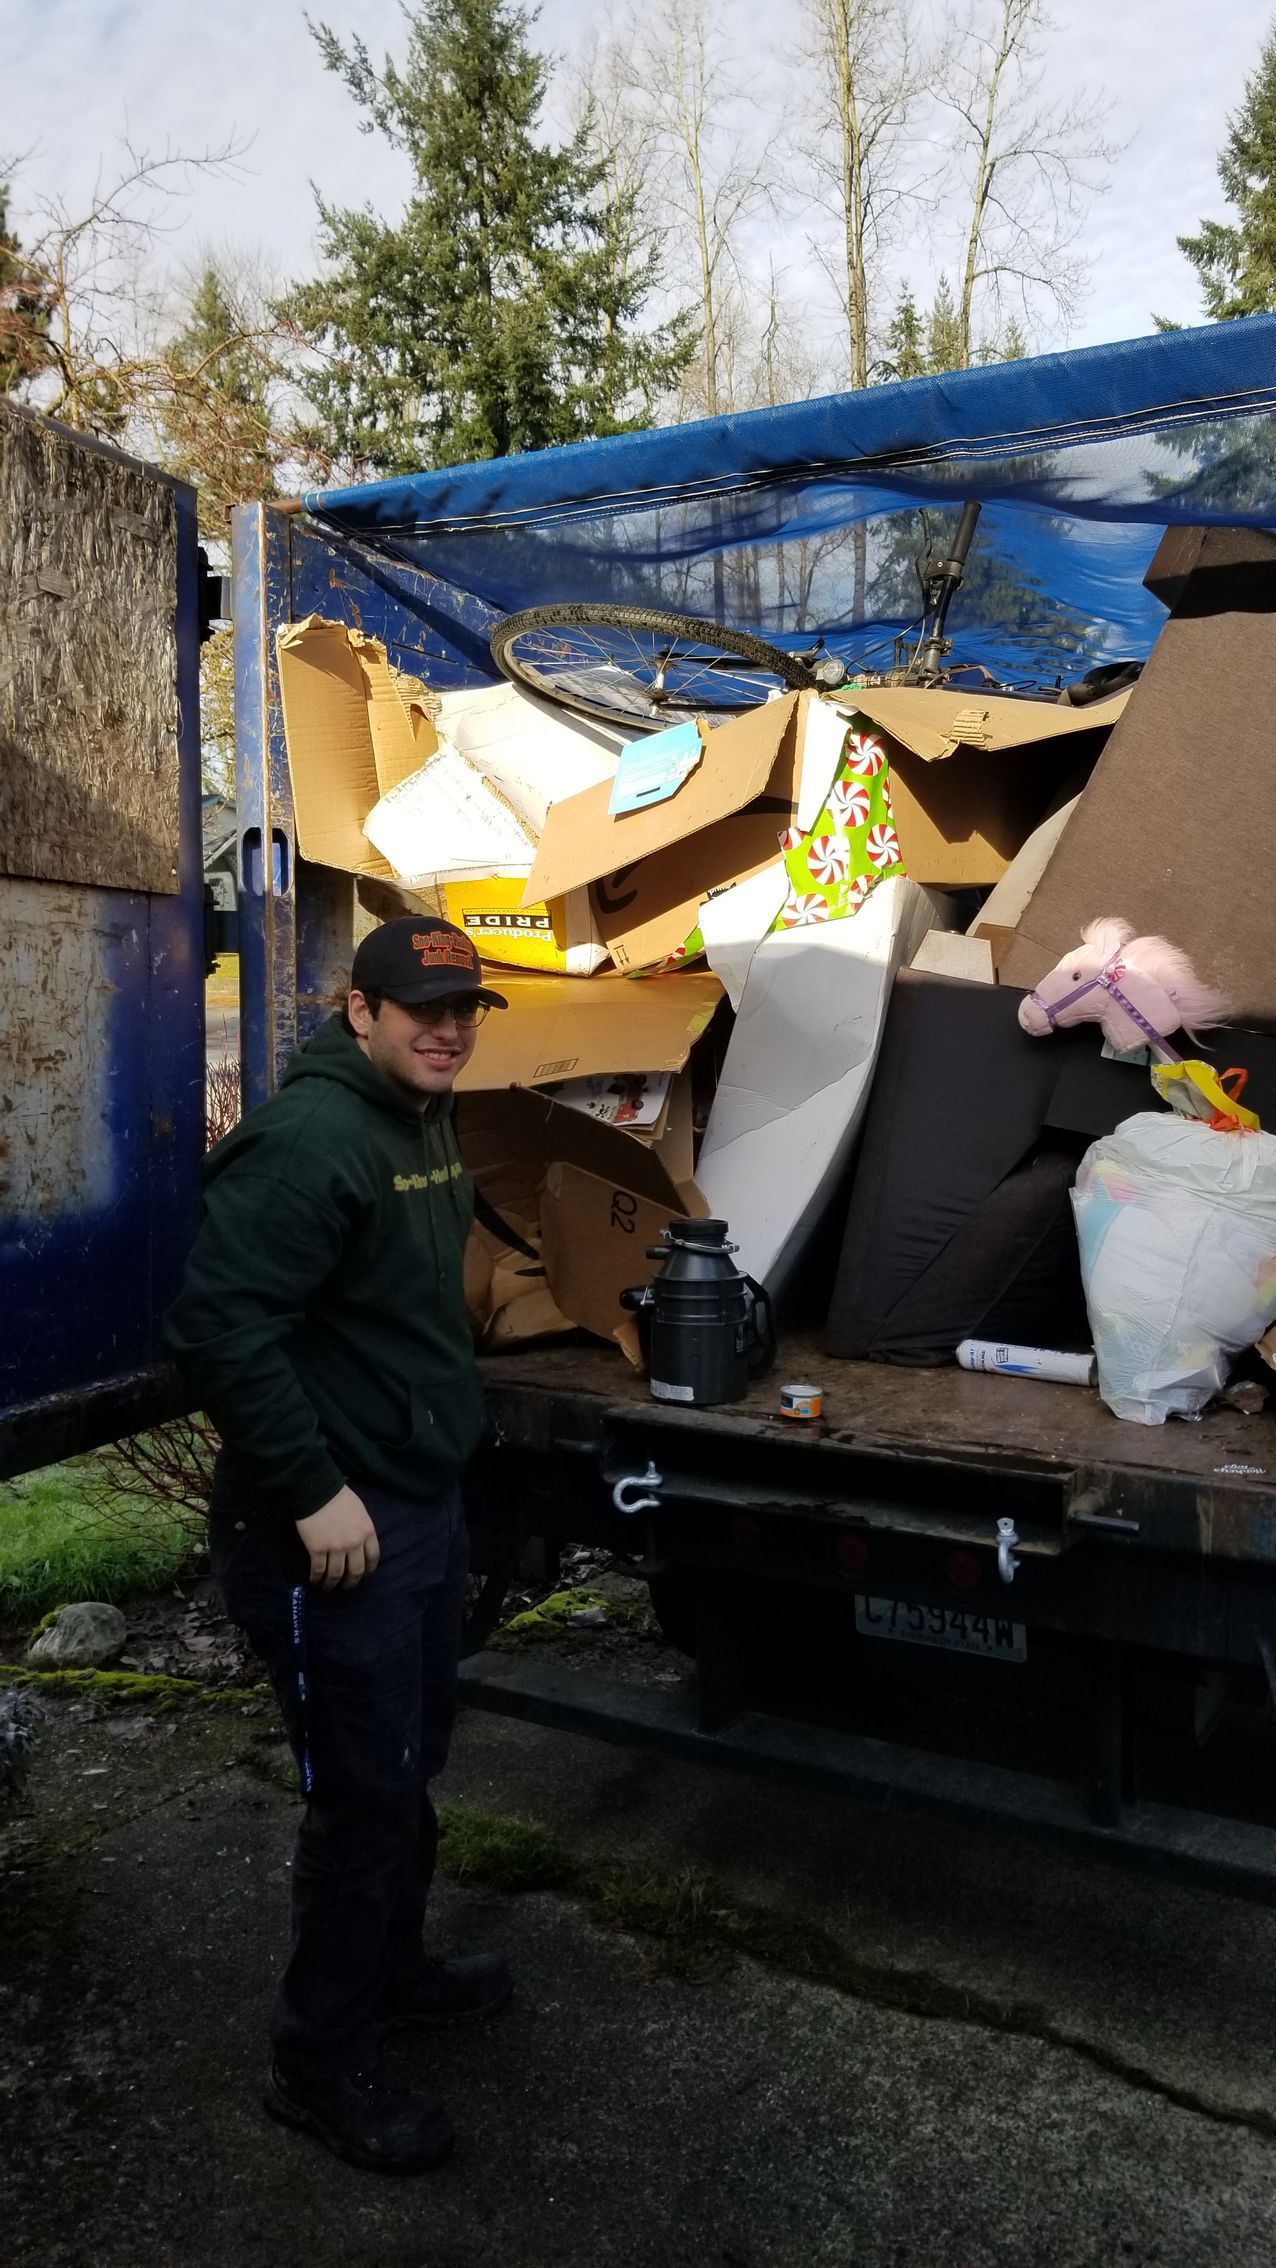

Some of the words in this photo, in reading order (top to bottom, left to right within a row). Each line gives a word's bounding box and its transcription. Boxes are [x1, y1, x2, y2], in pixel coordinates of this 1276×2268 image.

[466, 915, 550, 928] PRIDE
[466, 928, 553, 941] Producer's
[421, 949, 443, 966] Junk
[611, 1190, 637, 1234] Q2
